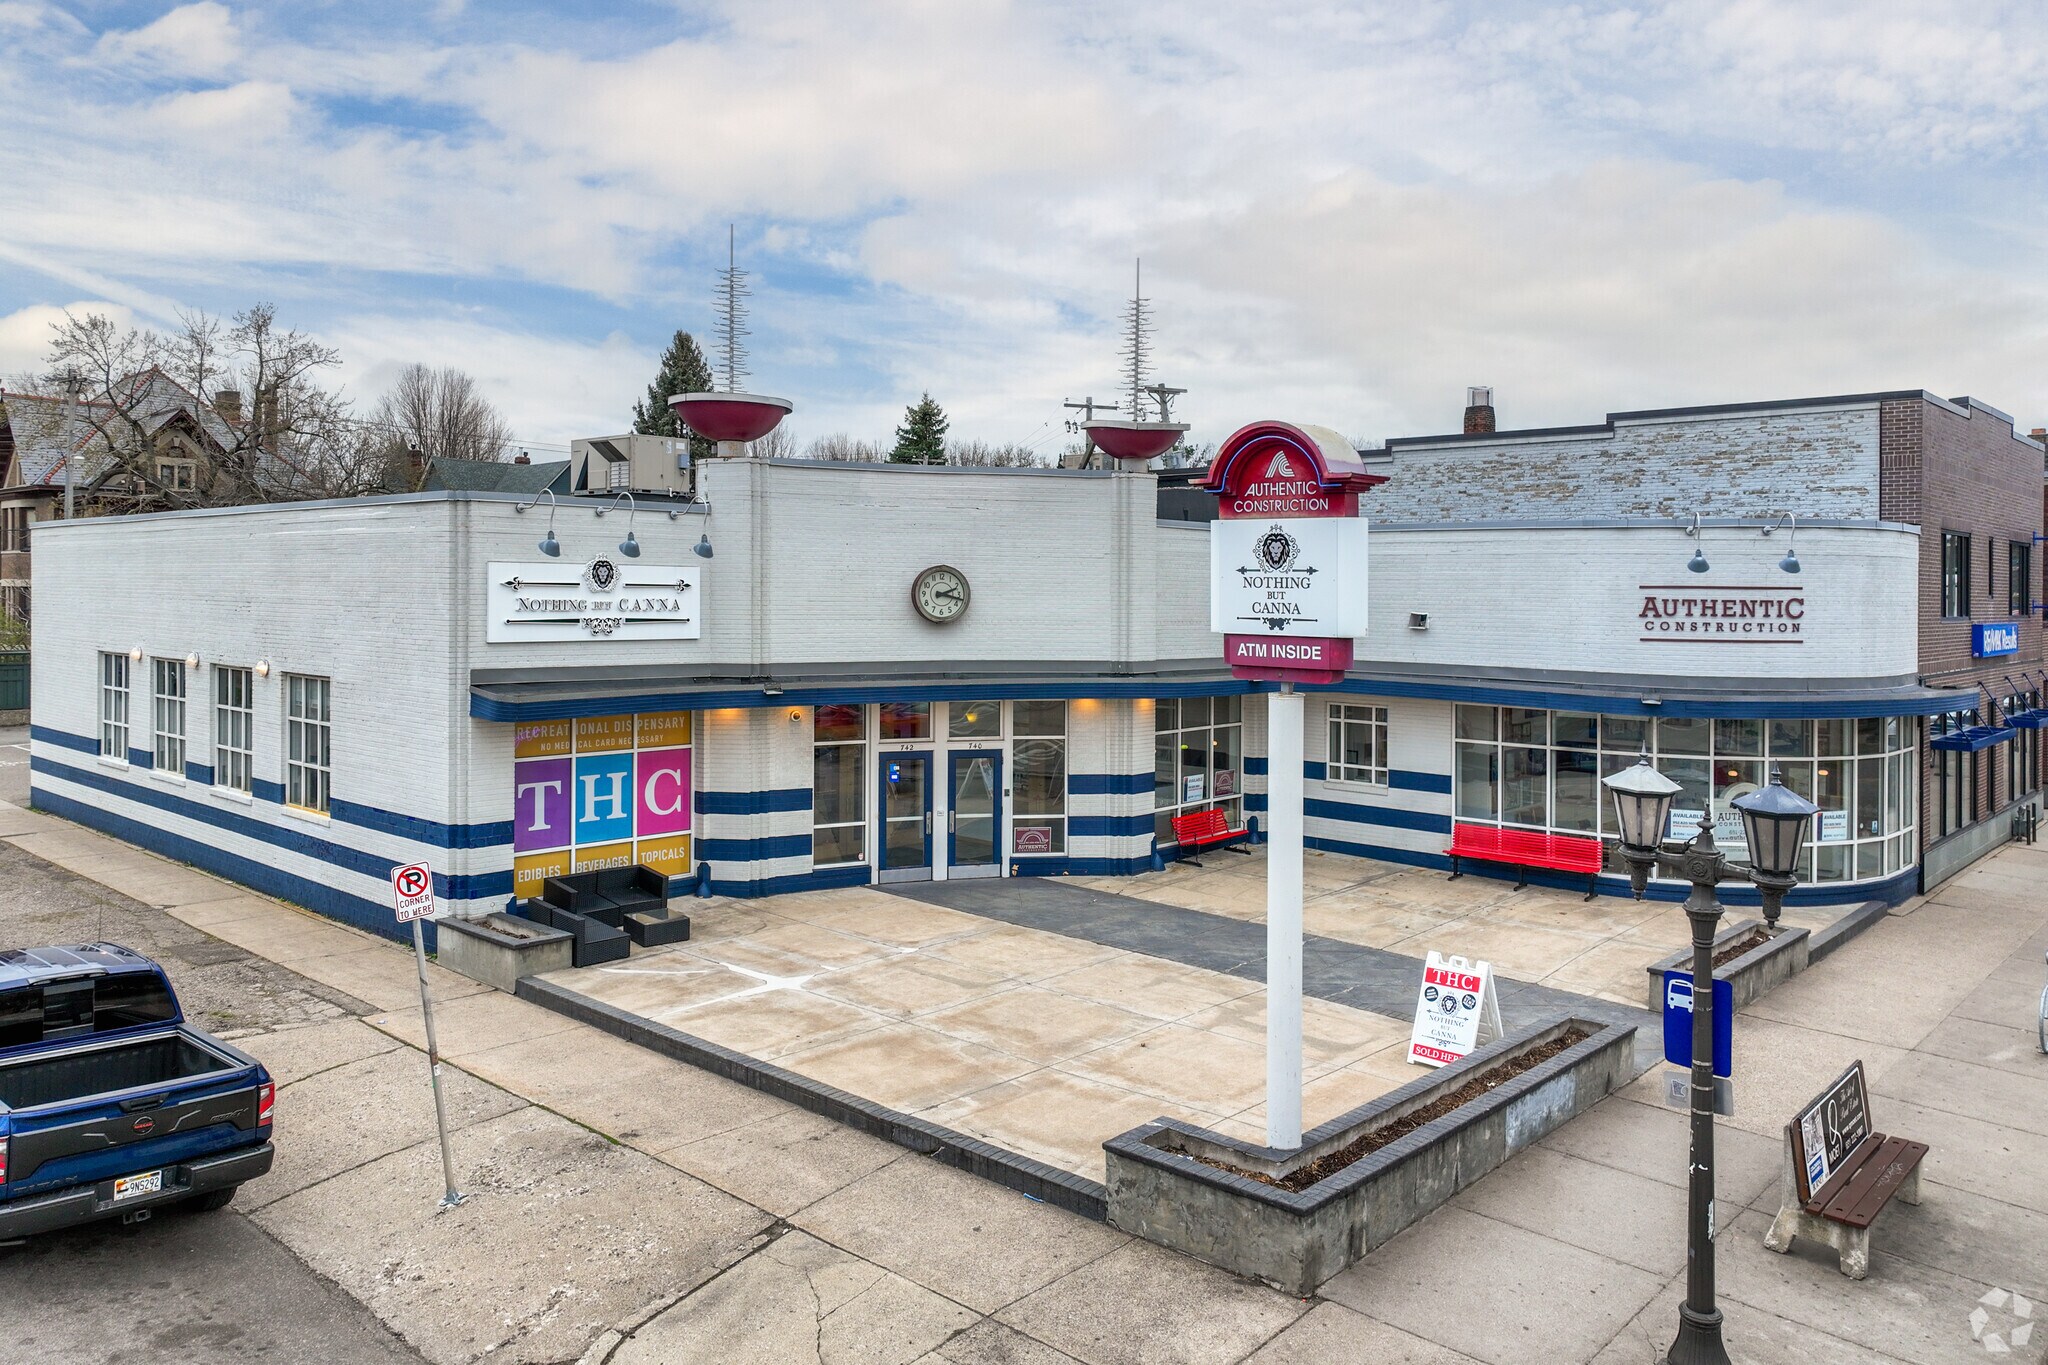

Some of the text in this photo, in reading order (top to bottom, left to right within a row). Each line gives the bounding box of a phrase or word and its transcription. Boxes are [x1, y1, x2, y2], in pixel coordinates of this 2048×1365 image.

[1244, 480, 1317, 497] AUTHENTIC
[1233, 498, 1329, 513] CONSTRUCTION
[1243, 576, 1311, 590] NOTHING
[1266, 591, 1286, 600] BUT
[515, 597, 681, 612] NOTHING BUT CANNA
[1252, 602, 1301, 615] CANNA
[1639, 597, 1804, 620] AUTHENTIC
[1644, 621, 1801, 633] CONSTRUCTION
[1237, 643, 1322, 660] ATM INSIDE
[614, 716, 686, 732] DISPENSARY
[540, 743, 551, 751] NO
[595, 738, 616, 747] CARD
[641, 847, 685, 864] TOPICALS
[576, 856, 629, 874] BEVERAGES
[518, 865, 561, 882] EDIBLES
[400, 894, 430, 908] CORNER
[400, 911, 409, 919] TO
[1433, 969, 1474, 990] THC
[1428, 1015, 1464, 1028] NOTHING
[1431, 1029, 1457, 1040] CANNA
[1416, 1046, 1440, 1058] SOLD
[130, 1177, 159, 1192] 9NS292
